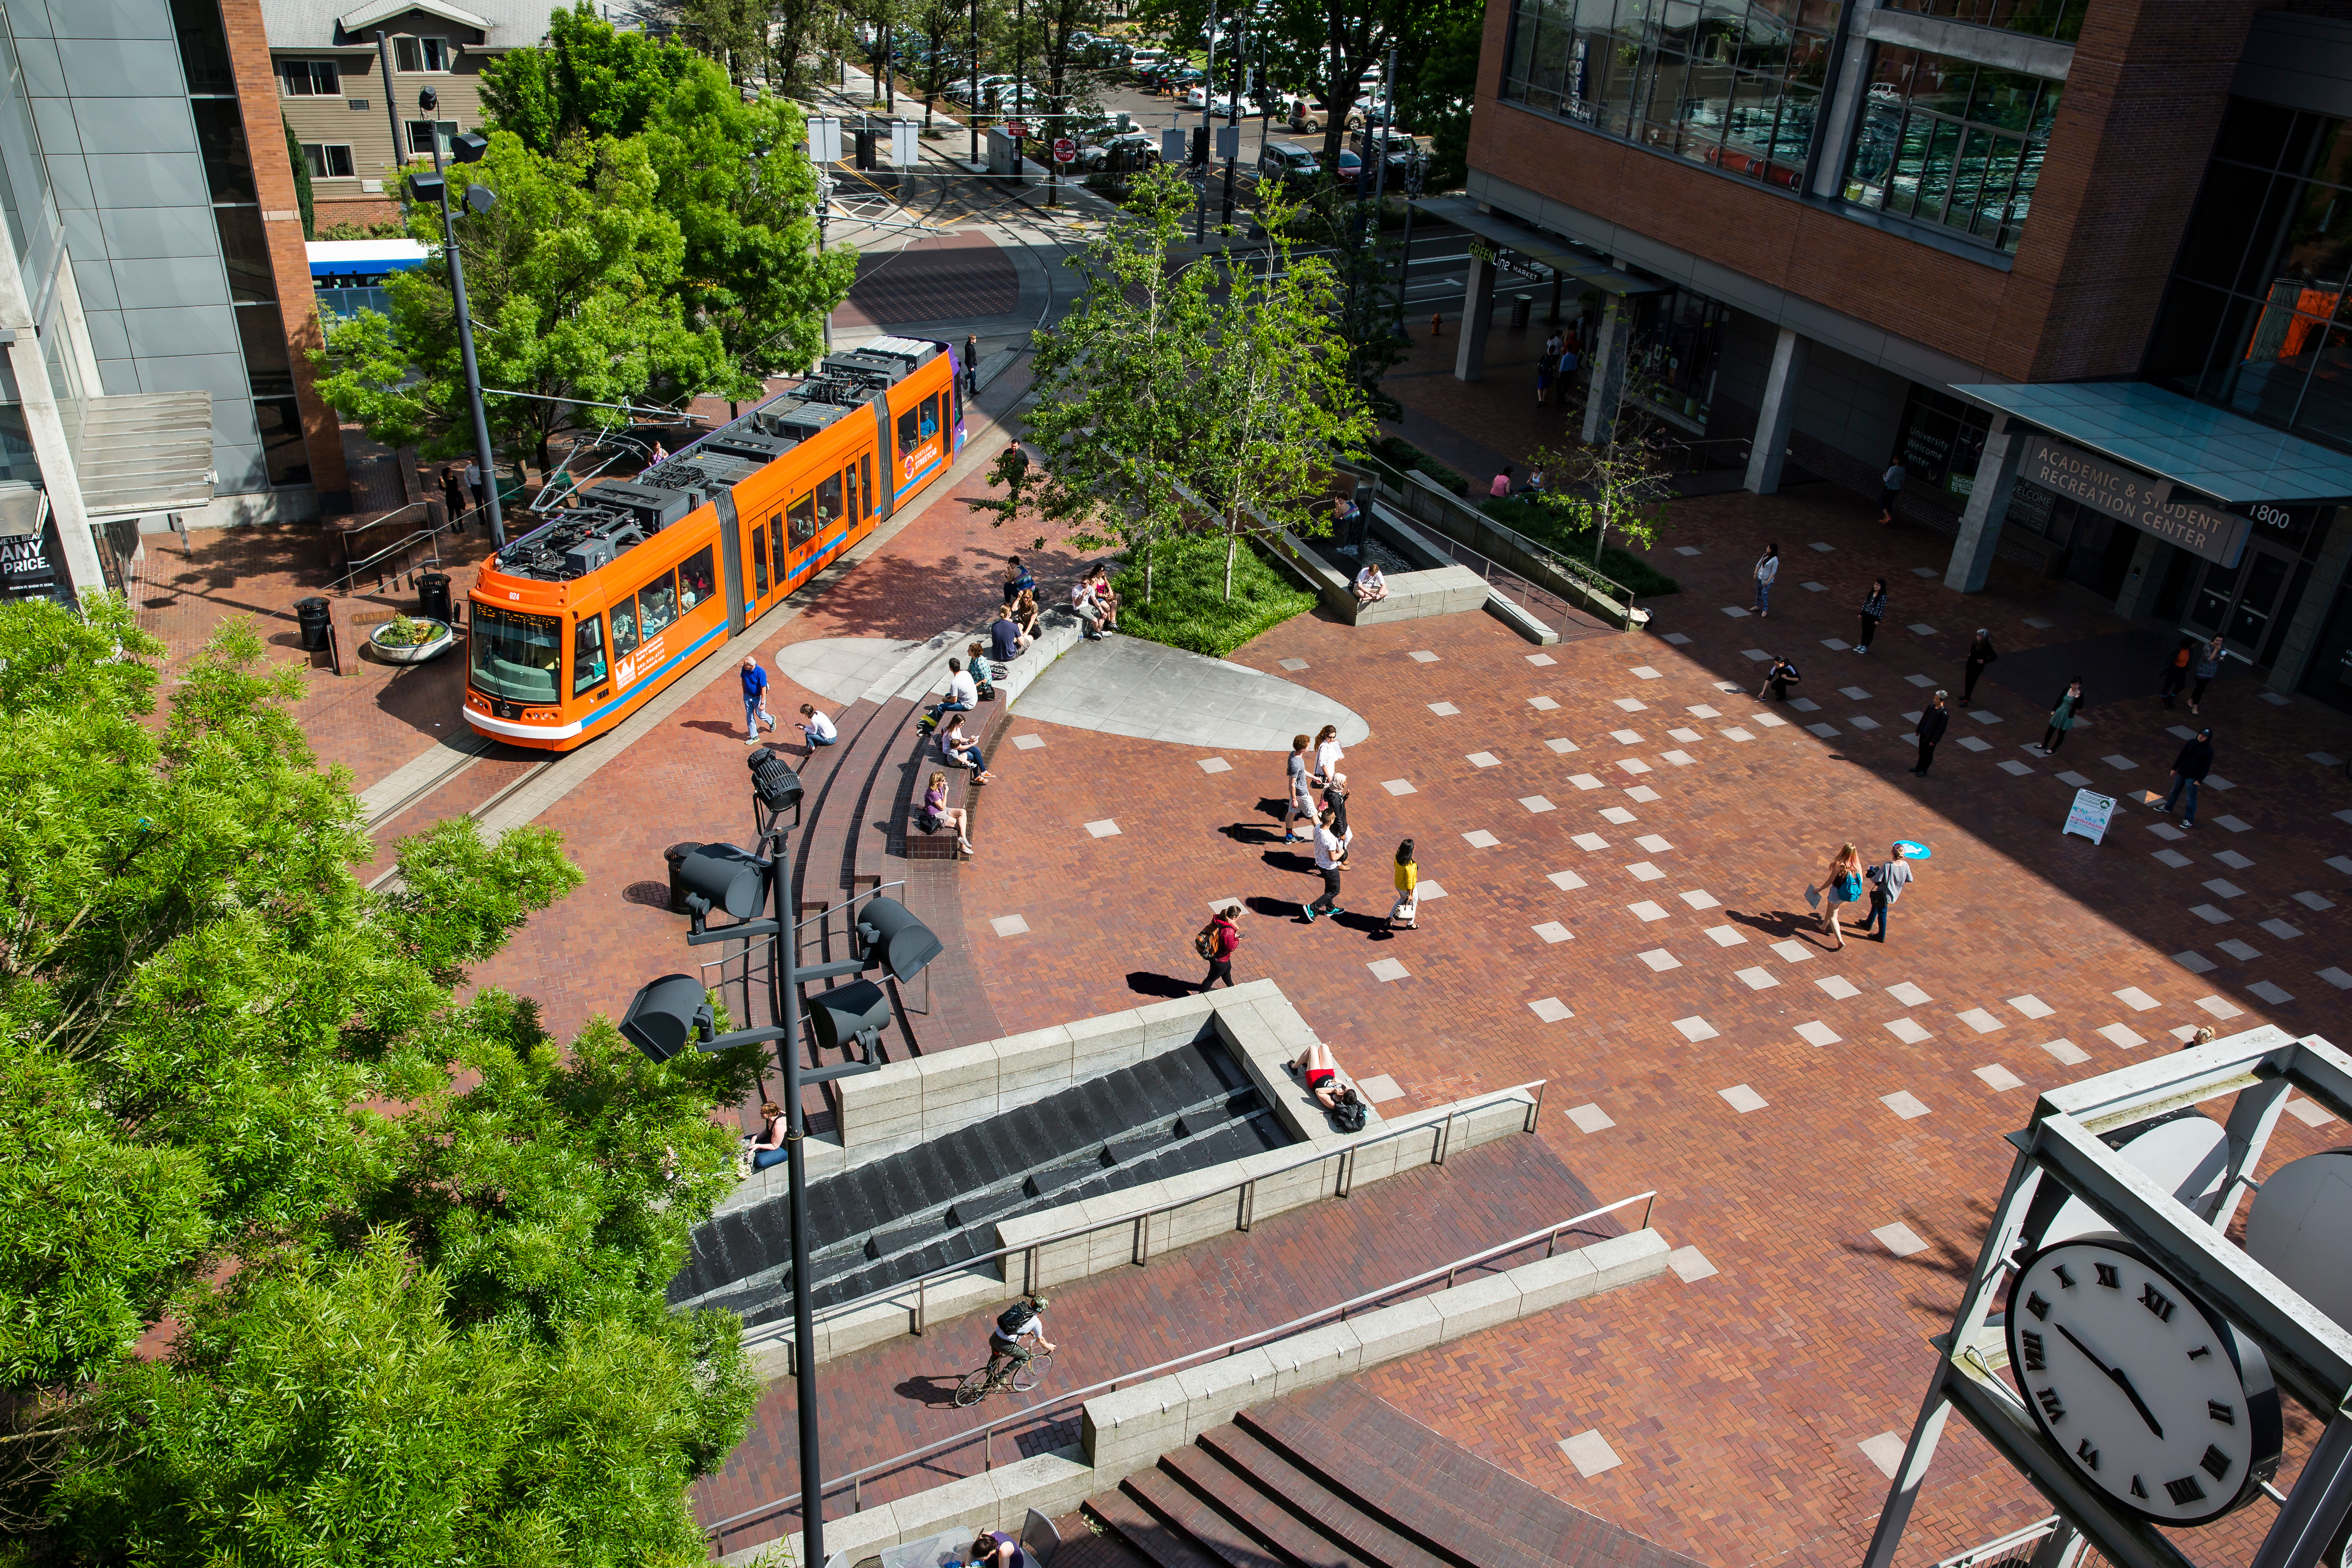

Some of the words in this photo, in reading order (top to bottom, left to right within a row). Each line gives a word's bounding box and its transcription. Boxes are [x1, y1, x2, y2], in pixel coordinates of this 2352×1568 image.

[1513, 265, 1538, 281] MARKET
[1907, 437, 1942, 461] Welcome
[1910, 426, 1949, 451] University
[915, 443, 932, 461] PORTLAND
[915, 447, 937, 469] STREETCAR
[2038, 447, 2120, 491] ACADEMIC
[2125, 484, 2136, 499] &
[1952, 481, 1972, 490] ROBOTS
[2040, 466, 2136, 518] RECREATION
[2142, 511, 2206, 549] CENTER
[2249, 505, 2289, 529] 1800
[0, 540, 43, 562] ANY
[4, 557, 50, 574] PRICE.
[509, 592, 519, 600] 024
[596, 664, 604, 674] NS
[2078, 796, 2099, 806] PROGRAM
[2079, 793, 2101, 803] OUTDOOR
[2051, 1264, 2076, 1289] X
[2137, 1282, 2177, 1323] XII
[2186, 1344, 2211, 1361] I
[2036, 1386, 2067, 1425] VII
[2207, 1399, 2235, 1426] II
[2076, 1437, 2099, 1471] VI
[2199, 1443, 2232, 1482] III
[2130, 1474, 2149, 1499] V
[2163, 1475, 2207, 1506] IIII
